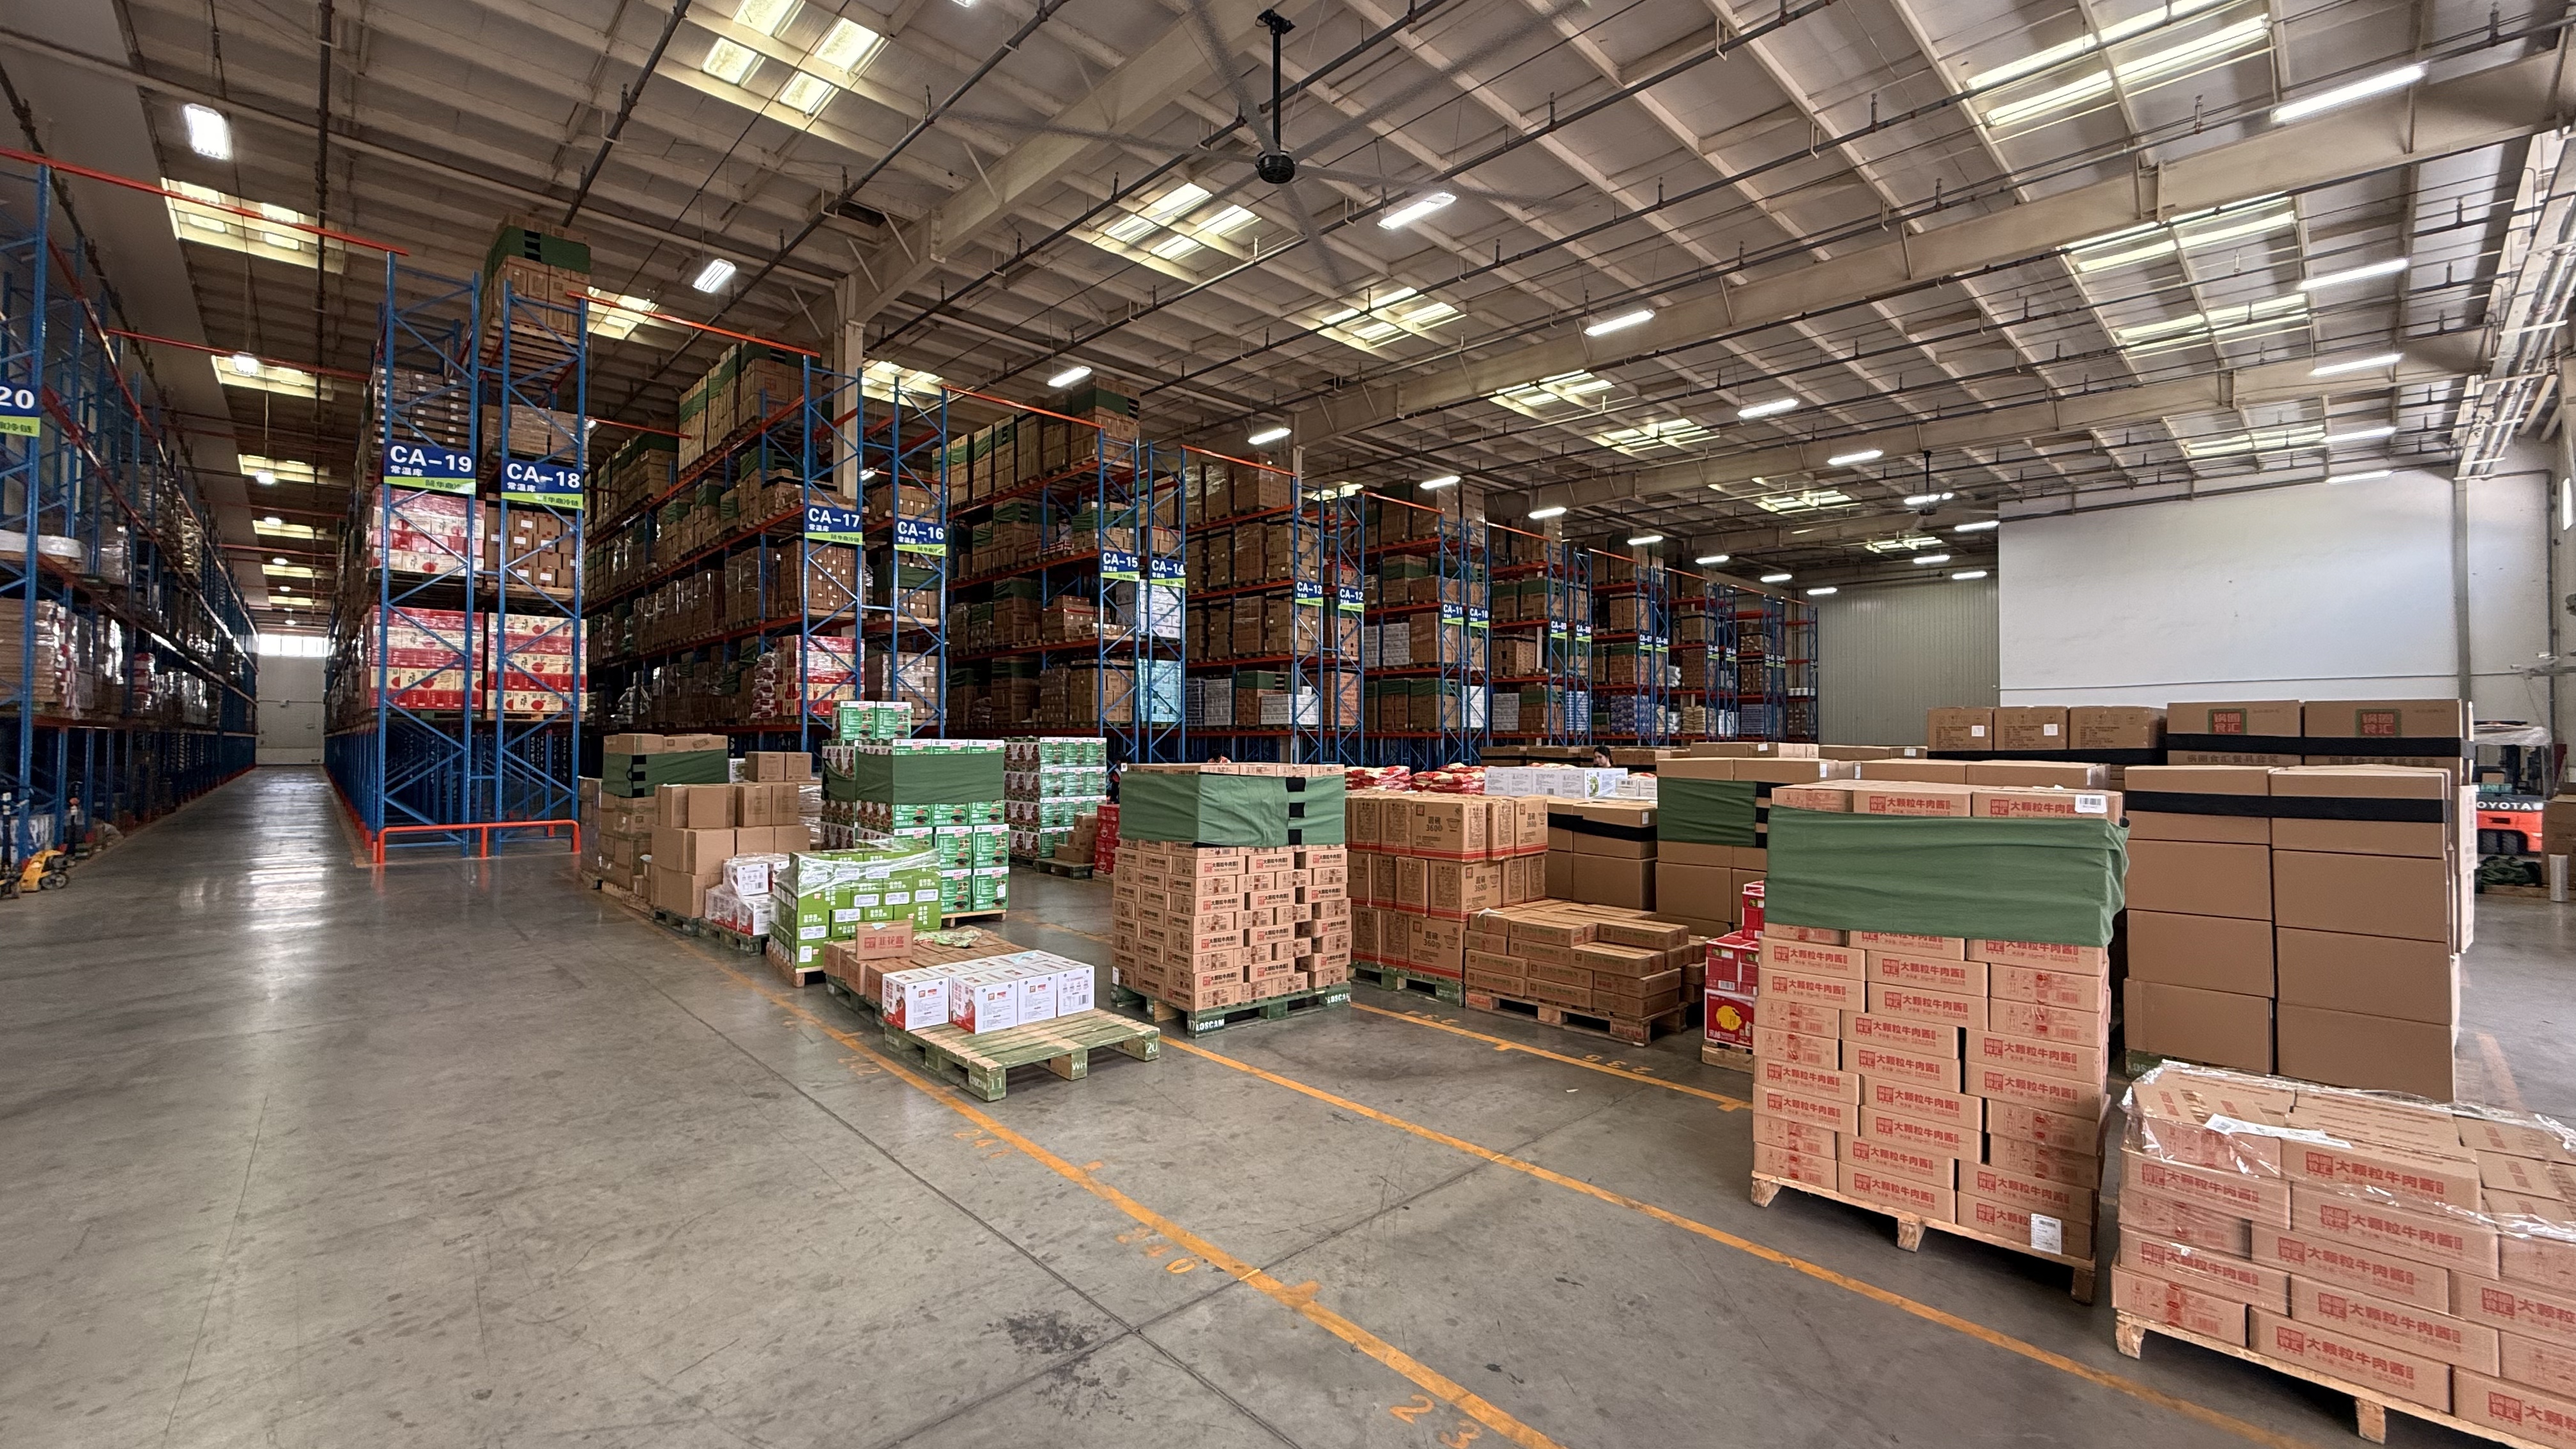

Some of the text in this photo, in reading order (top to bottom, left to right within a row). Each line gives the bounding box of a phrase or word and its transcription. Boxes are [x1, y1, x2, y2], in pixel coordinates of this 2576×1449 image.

[390, 446, 471, 472] CA-19
[390, 465, 423, 476] 常温库
[507, 463, 580, 488] CA-18
[507, 482, 536, 492] 常温库
[808, 508, 860, 527] CA-17
[898, 521, 944, 540] CA-16
[1103, 553, 1138, 568] CA-15
[1152, 560, 1185, 576] CA-14
[1297, 581, 1322, 594] CA-13
[1340, 588, 1363, 601] CA-12
[1443, 604, 1462, 615] CA-11
[1470, 608, 1488, 618] CA-10
[2213, 713, 2241, 723] 锅圈
[2363, 713, 2394, 723] 锅圈
[2214, 723, 2241, 733] 食汇
[2363, 723, 2394, 735] 食汇
[1887, 798, 1946, 809] 大颗粒牛肉酱
[2011, 801, 2076, 814] 大颗粒牛肉酱
[2476, 801, 2531, 810] OYOTA
[1790, 949, 1843, 963] 大颗粒牛肉酱
[1901, 962, 1960, 979] 大颗粒牛肉酱
[1789, 979, 1841, 995] 大颗粒牛肉酱
[1903, 995, 1963, 1012] 大颗粒牛肉酱
[1196, 1018, 1225, 1031] LOSCAM
[1873, 1022, 1931, 1039] 大颗粒牛肉酱
[1146, 1042, 1158, 1054] 20
[2004, 1043, 2071, 1063] 大颗粒牛肉酱
[1072, 1061, 1086, 1071] WH
[1877, 1055, 1936, 1073] 大颗粒牛肉酱
[990, 1077, 1002, 1090] 11
[1783, 1068, 1835, 1085] 大颗粒牛肉酱
[2005, 1077, 2072, 1098] 大颗粒牛肉酱
[1784, 1098, 1836, 1116] 大颗粒牛肉酱
[1896, 1090, 1954, 1110] 大颗粒牛肉酱
[1894, 1122, 1954, 1142] 大颗粒牛肉酱
[1871, 1147, 1928, 1169] 大颗粒牛肉酱
[2336, 1160, 2434, 1194] 大颗粒牛肉酱
[1873, 1179, 1930, 1202] 大颗粒牛肉酱
[1998, 1177, 2064, 1201] 大颗粒牛肉酱
[2352, 1214, 2453, 1248] 大颗粒牛肉酱
[2308, 1247, 2405, 1284] 大颗粒牛肉酱
[2349, 1303, 2451, 1342] 大颗粒牛肉酱
[2306, 1337, 2404, 1377] 大颗粒牛肉酱
